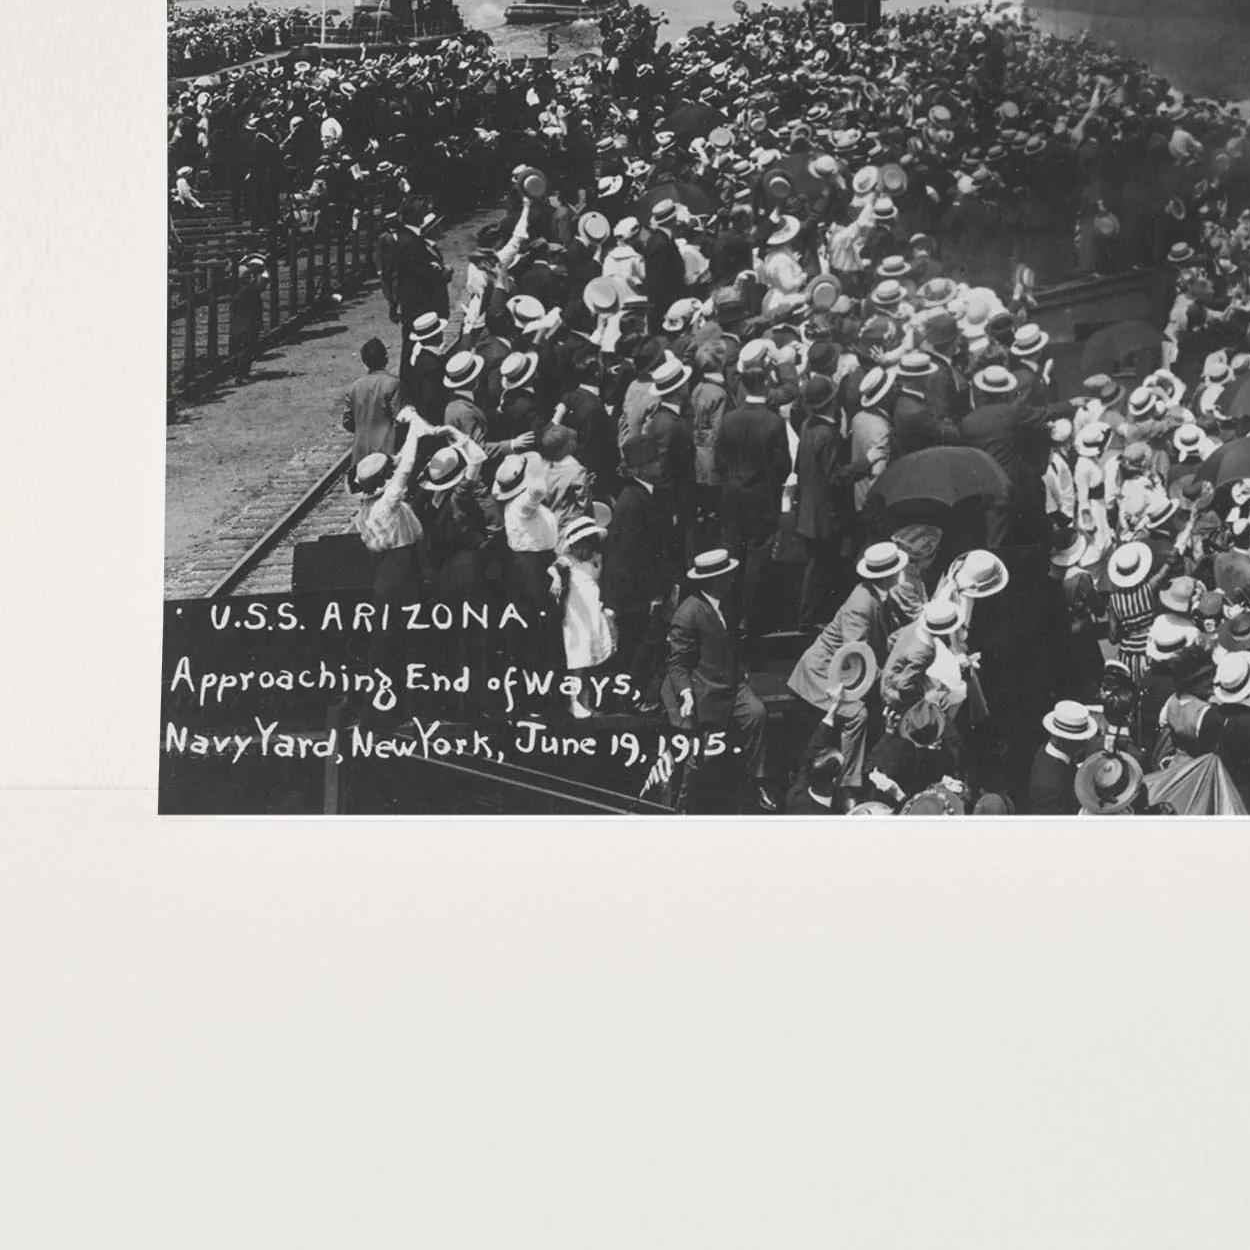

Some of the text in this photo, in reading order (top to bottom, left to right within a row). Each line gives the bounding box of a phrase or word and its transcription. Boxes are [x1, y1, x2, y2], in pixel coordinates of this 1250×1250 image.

[210, 601, 528, 632] U.S.S. ARIZONA
[170, 656, 397, 711] Approaching
[406, 663, 470, 693] End
[515, 720, 597, 756] June
